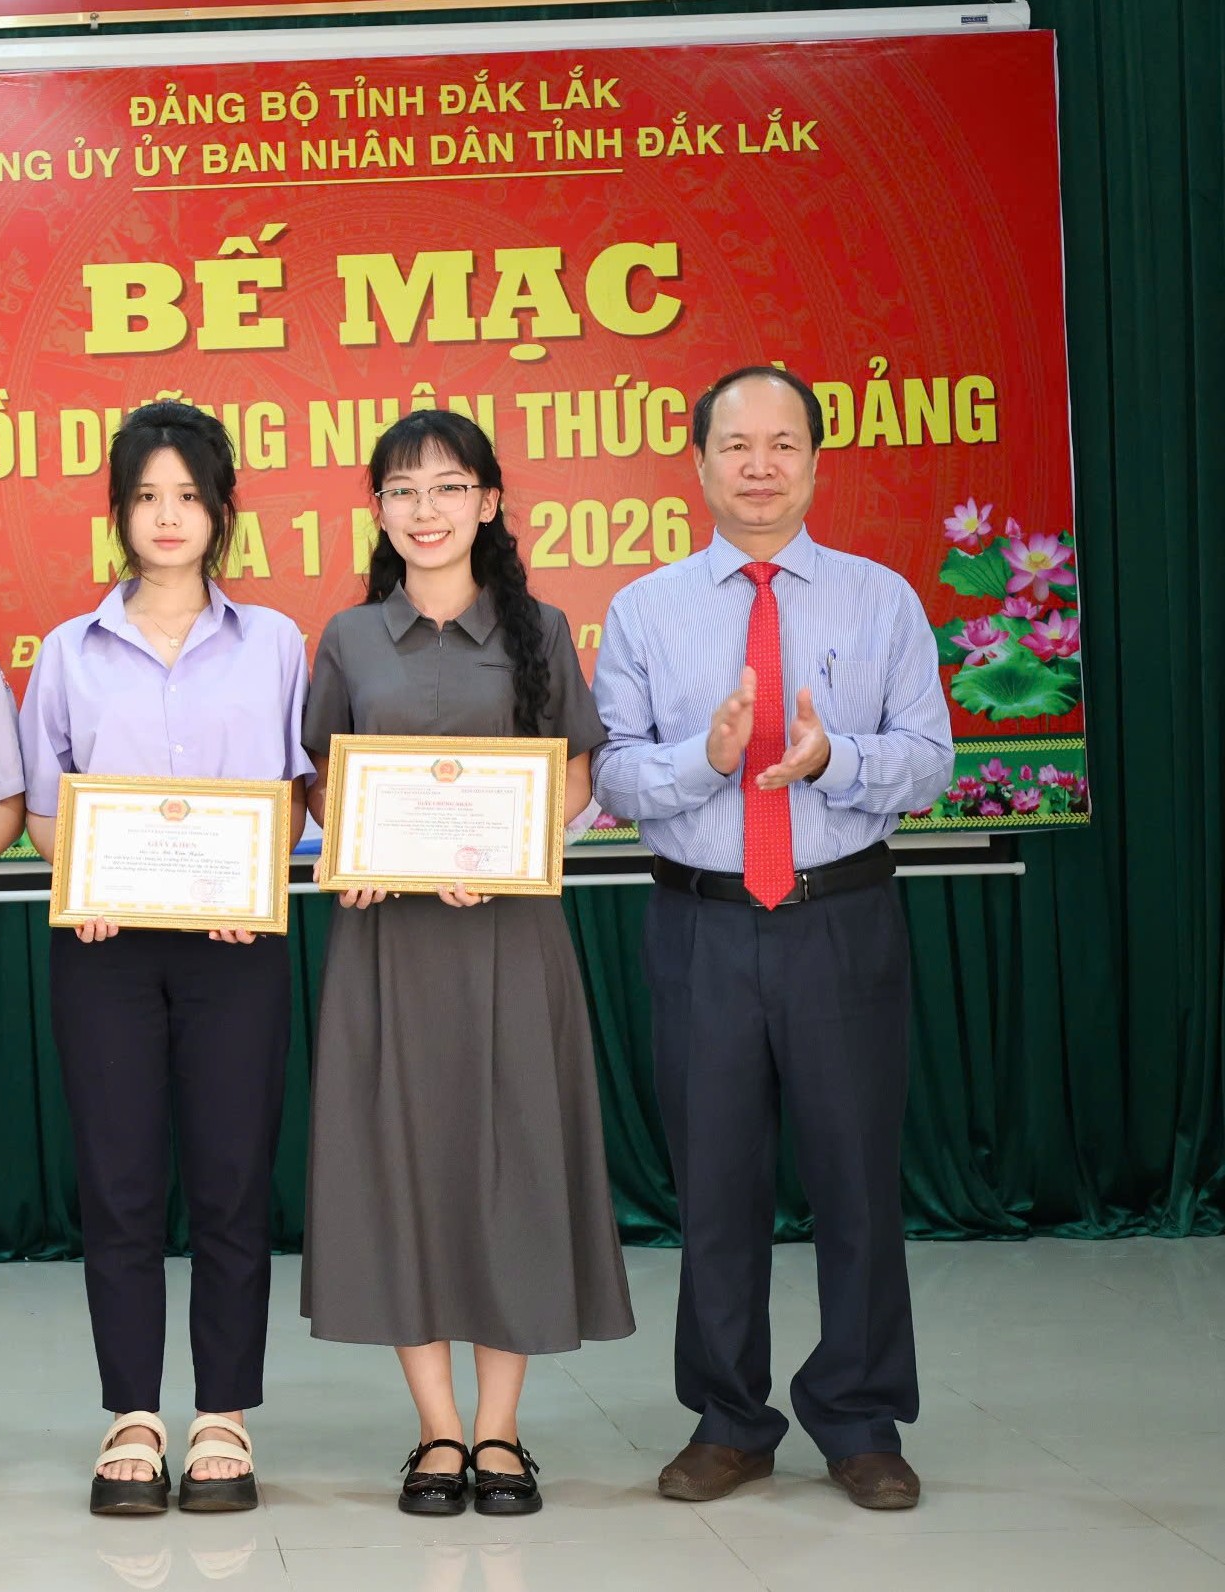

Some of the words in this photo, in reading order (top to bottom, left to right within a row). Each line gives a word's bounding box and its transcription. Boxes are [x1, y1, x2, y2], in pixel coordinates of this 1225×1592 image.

[129, 83, 245, 126] ĐẢNG
[261, 82, 319, 127] BỘ
[331, 76, 425, 118] TỈNH
[439, 69, 526, 115] ĐẮK
[539, 65, 621, 111] LẮK
[68, 136, 120, 179] ỦY
[134, 133, 187, 177] ỦY
[203, 142, 286, 174] BAN
[302, 130, 415, 170] NHÂN
[431, 126, 514, 166] DÂN
[528, 117, 623, 161] TỈNH
[637, 111, 724, 158] ĐẮK
[738, 108, 820, 154] LẮK
[82, 222, 288, 355] BẾ
[337, 242, 682, 360] MẠC
[516, 373, 688, 459] THỨC
[819, 355, 998, 449] ĐẢNG
[91, 511, 271, 584] KA
[291, 510, 321, 577] 1
[530, 497, 692, 569] 2026
